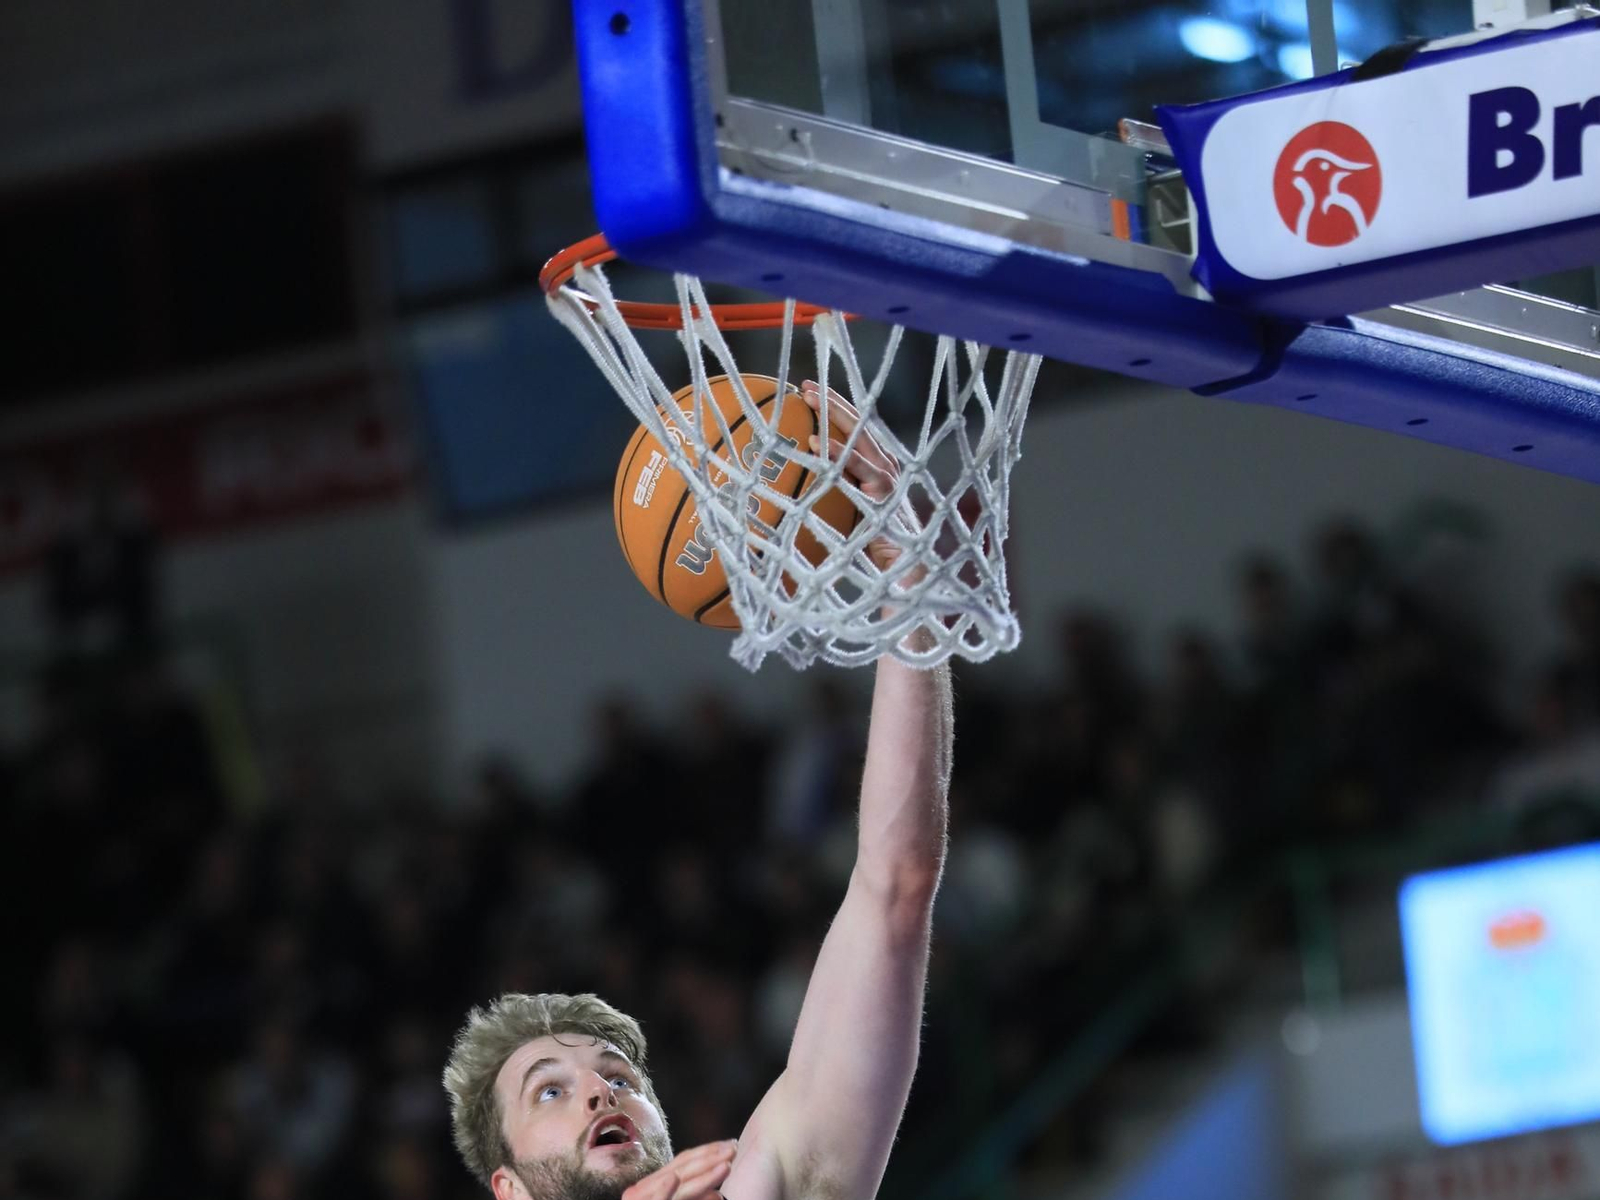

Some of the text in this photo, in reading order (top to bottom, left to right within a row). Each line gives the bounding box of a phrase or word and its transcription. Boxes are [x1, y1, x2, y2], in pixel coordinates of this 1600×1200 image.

[1467, 86, 1600, 199] Br
[633, 450, 662, 506] FEB
[642, 456, 668, 509] PRIMERA
